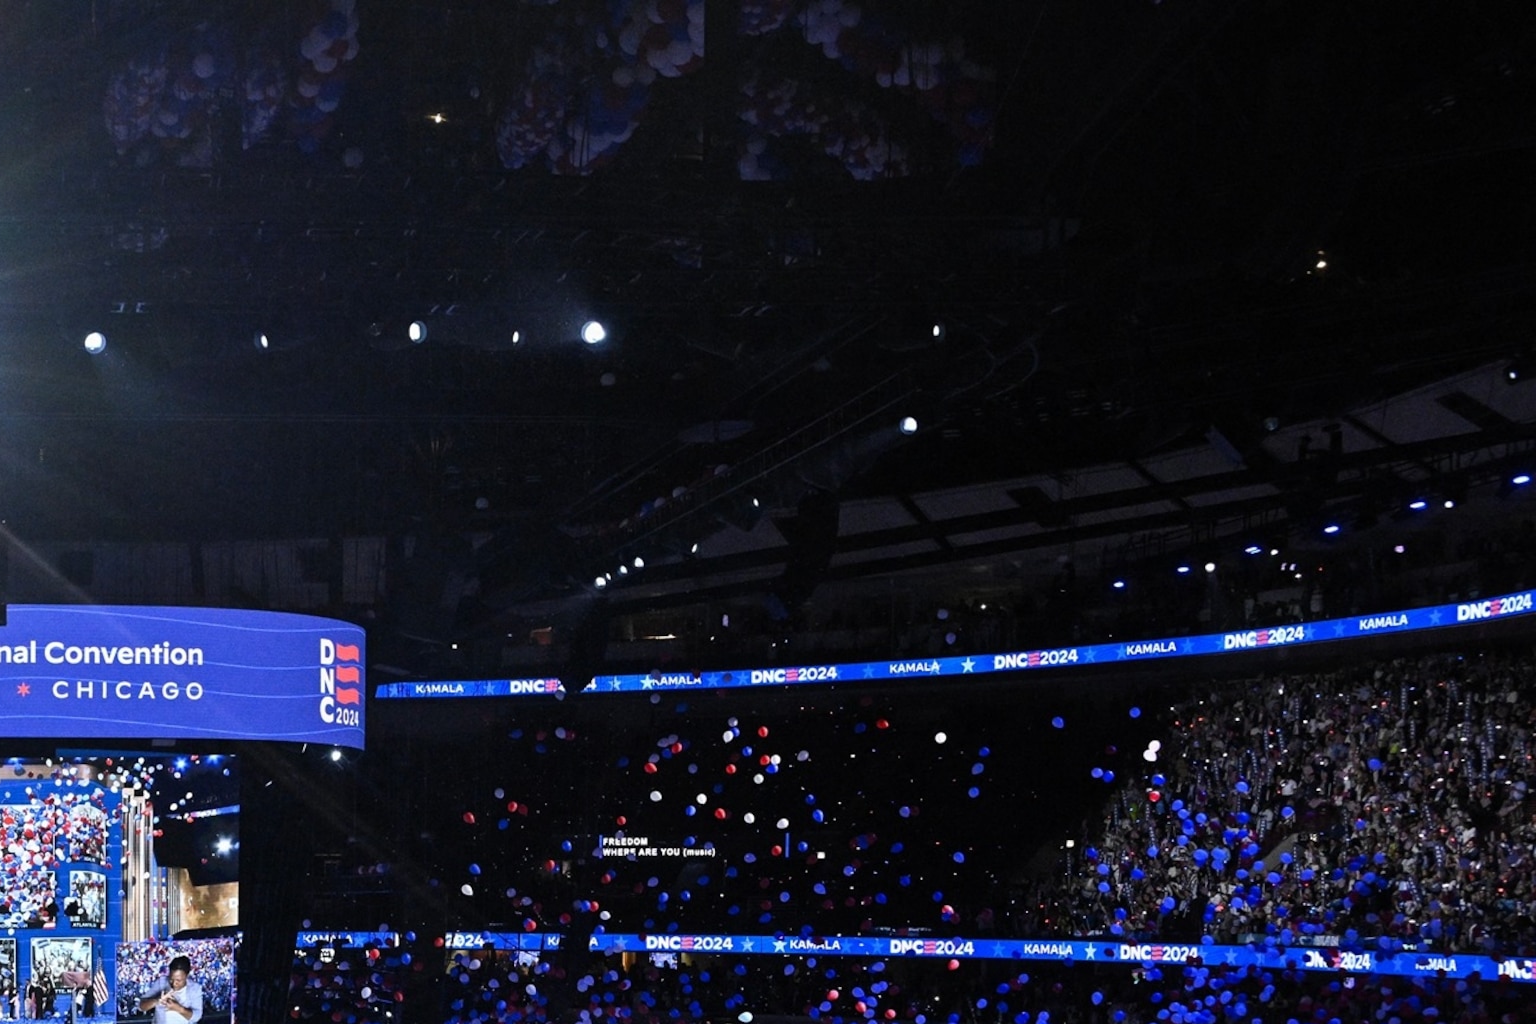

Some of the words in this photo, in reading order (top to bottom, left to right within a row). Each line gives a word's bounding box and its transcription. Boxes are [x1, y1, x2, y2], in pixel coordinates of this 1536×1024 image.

[1457, 601, 1492, 621] DNC
[1500, 593, 1533, 615] 2024
[1359, 614, 1408, 630] KAMALA
[1224, 631, 1257, 649] DNC
[1267, 625, 1305, 644] 2024
[44, 642, 204, 667] Convention
[1126, 641, 1177, 655] KAMALA
[994, 653, 1028, 670] DNC
[1040, 649, 1078, 665] 2024
[751, 669, 786, 684] DNC
[798, 666, 838, 681] 2024
[889, 662, 941, 674] KAMALA
[52, 681, 205, 700] CHICAGO
[415, 683, 464, 694] KAMALA
[336, 705, 360, 728] 2024
[603, 837, 649, 846] FREEDOM
[602, 848, 636, 857] WHERE
[638, 848, 658, 857] ARE
[661, 848, 680, 857] YOU
[683, 848, 716, 858] (music)
[646, 936, 680, 950] DNC
[693, 937, 734, 951] 2024
[1024, 943, 1073, 955] KAMALA
[1120, 945, 1151, 960] DNC
